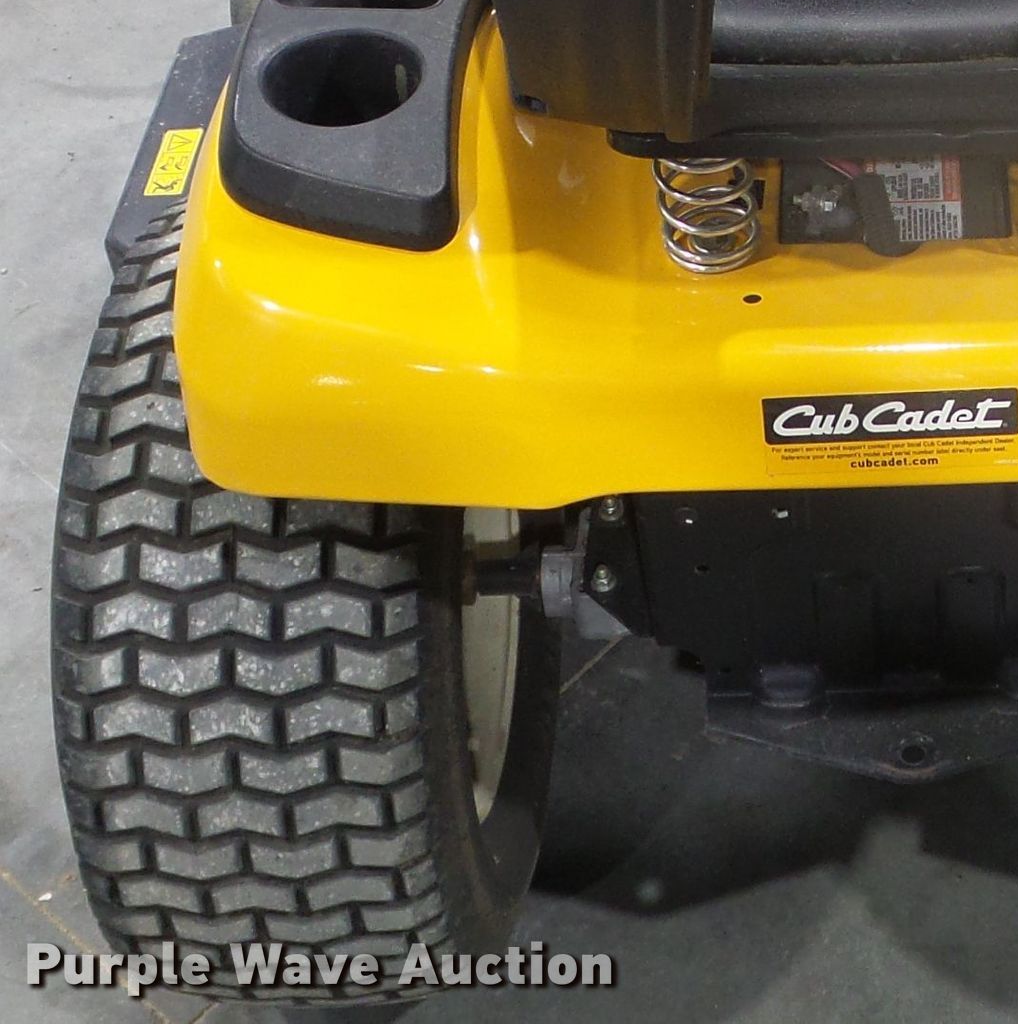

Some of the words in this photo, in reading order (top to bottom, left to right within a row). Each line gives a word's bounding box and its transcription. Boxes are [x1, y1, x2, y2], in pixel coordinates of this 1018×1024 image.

[773, 403, 859, 437] Cub
[862, 398, 1012, 434] Cadet
[850, 457, 939, 468] cubcadet.com
